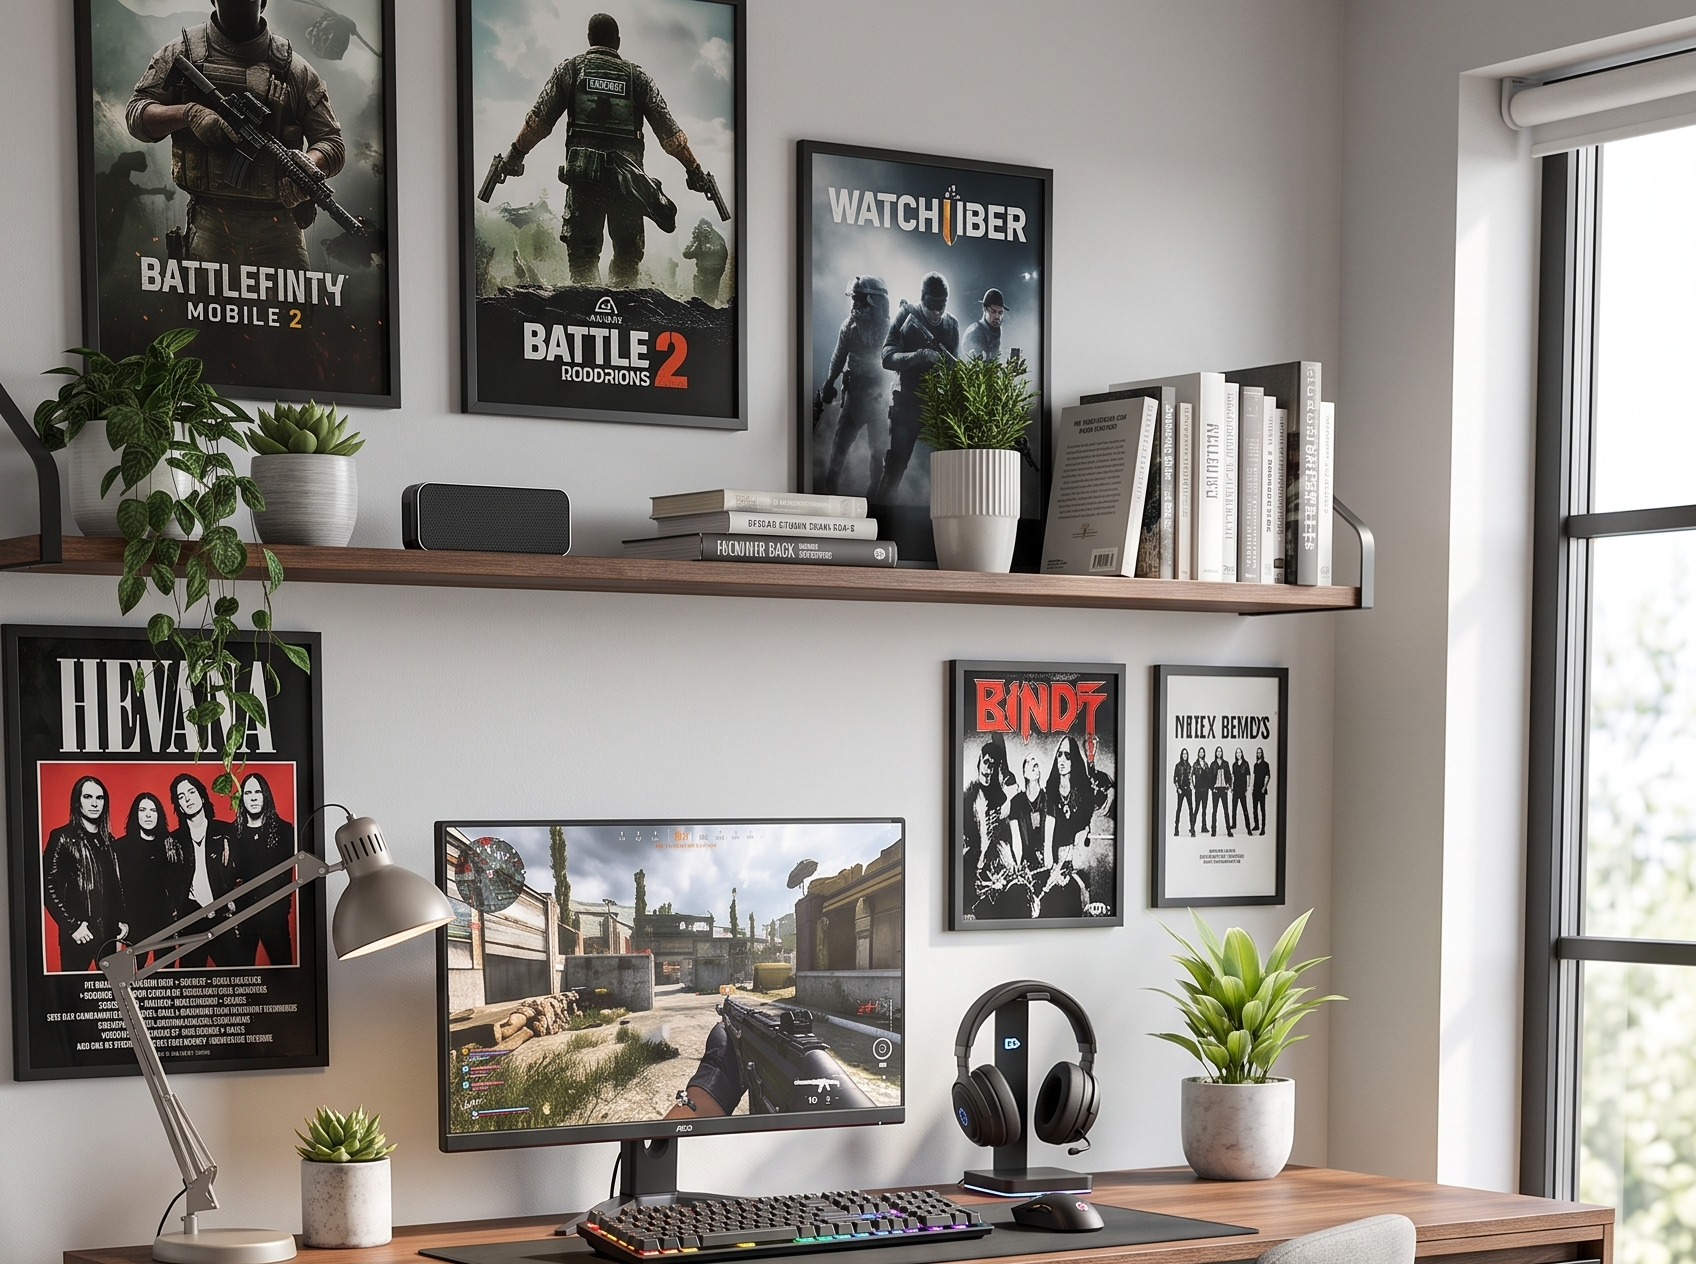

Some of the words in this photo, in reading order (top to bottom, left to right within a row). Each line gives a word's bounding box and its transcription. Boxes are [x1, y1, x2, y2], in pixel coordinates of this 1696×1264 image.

[140, 256, 345, 307] BATTLEFINTY
[187, 301, 280, 327] MOBILE
[289, 309, 302, 329] 2
[523, 321, 650, 368] BATTLE
[654, 331, 688, 389] 2
[561, 365, 650, 387] RODDRIONS
